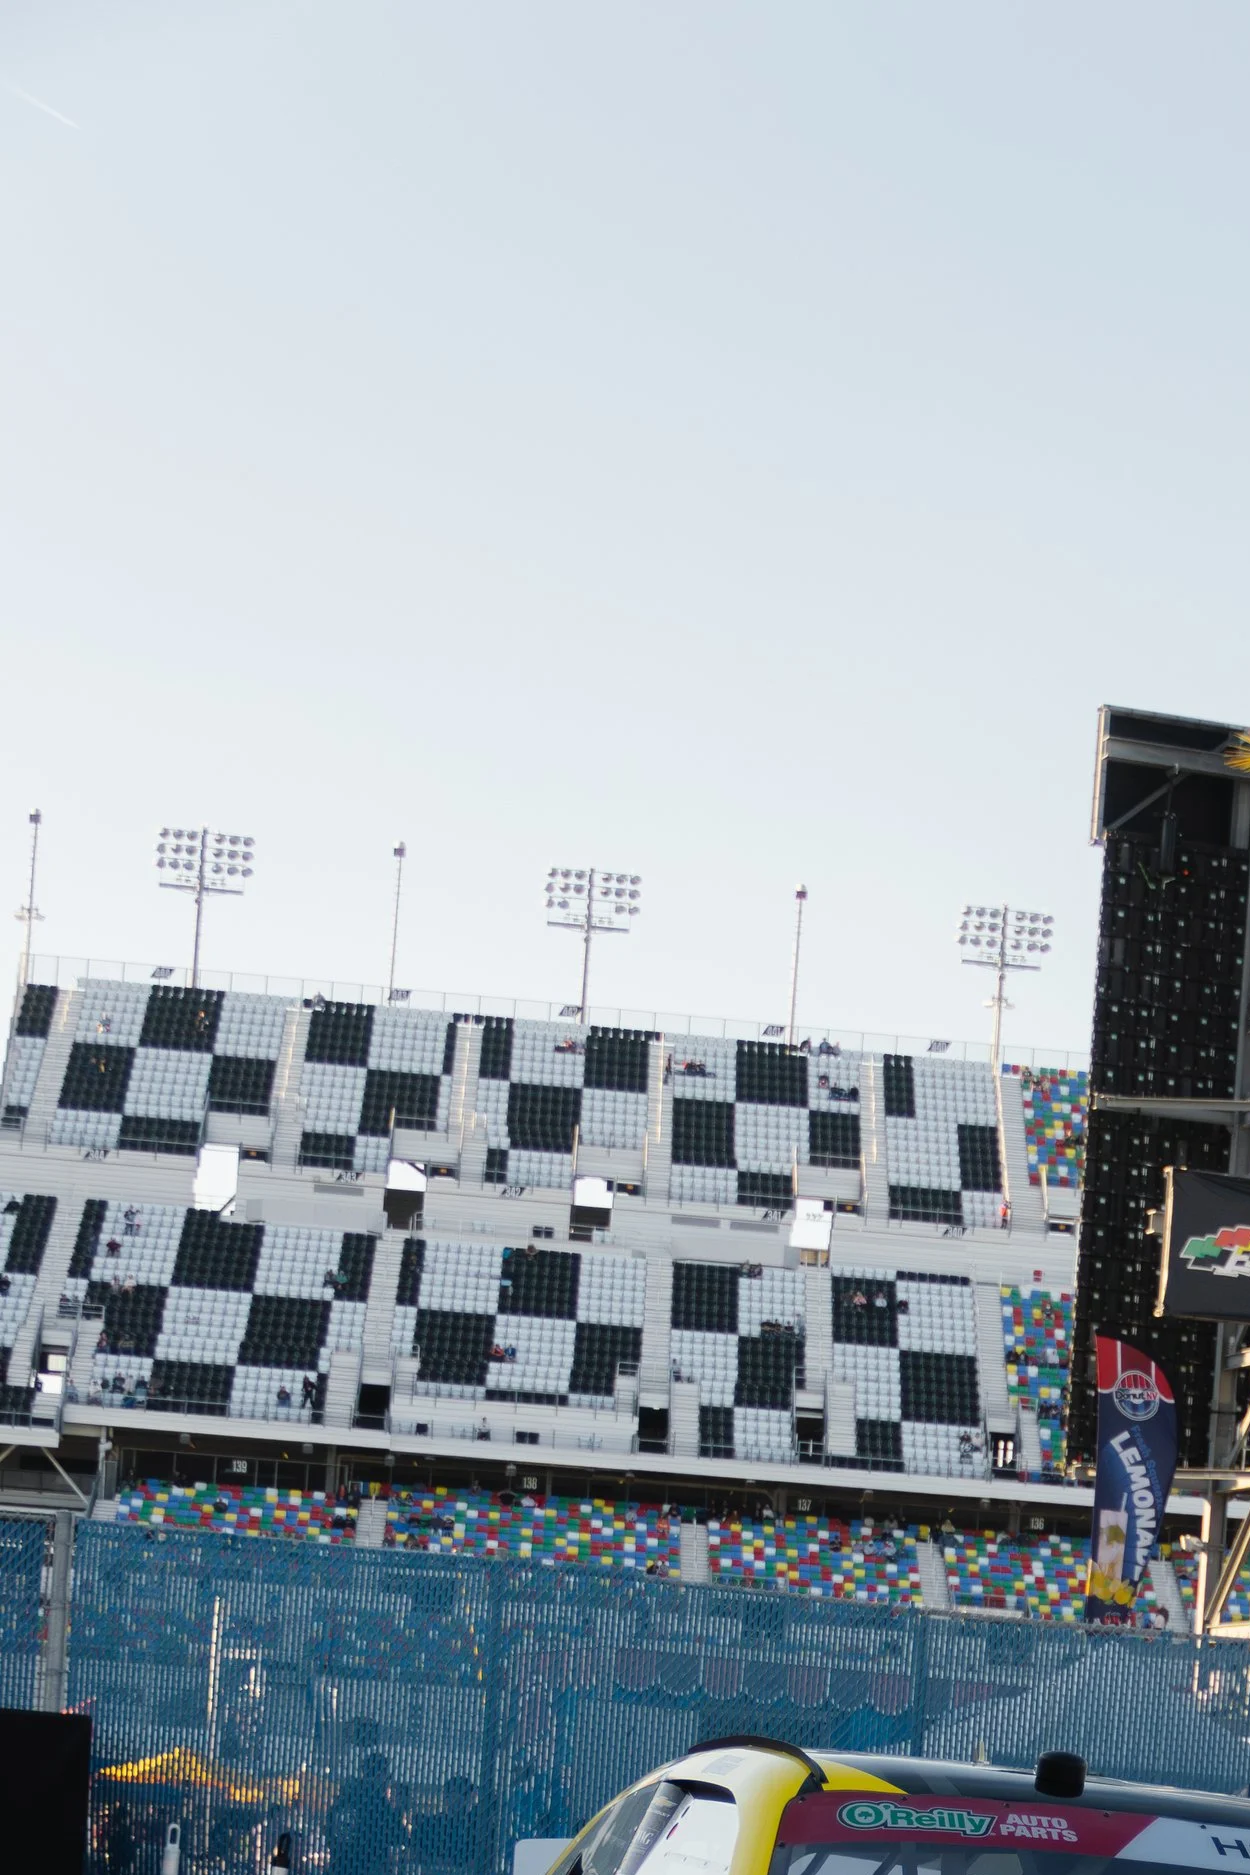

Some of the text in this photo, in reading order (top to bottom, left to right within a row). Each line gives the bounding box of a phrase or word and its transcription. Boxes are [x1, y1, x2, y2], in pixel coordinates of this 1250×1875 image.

[341, 1171, 357, 1183] 343
[505, 1186, 521, 1198] 342
[767, 1209, 782, 1222] 341
[232, 1460, 248, 1474] 139
[523, 1476, 538, 1490] 138
[797, 1499, 812, 1512] 137
[1030, 1518, 1045, 1531] 136
[844, 1803, 991, 1836] O'Reilly
[1007, 1813, 1069, 1829] AUTO
[1000, 1824, 1078, 1842] PARTS
